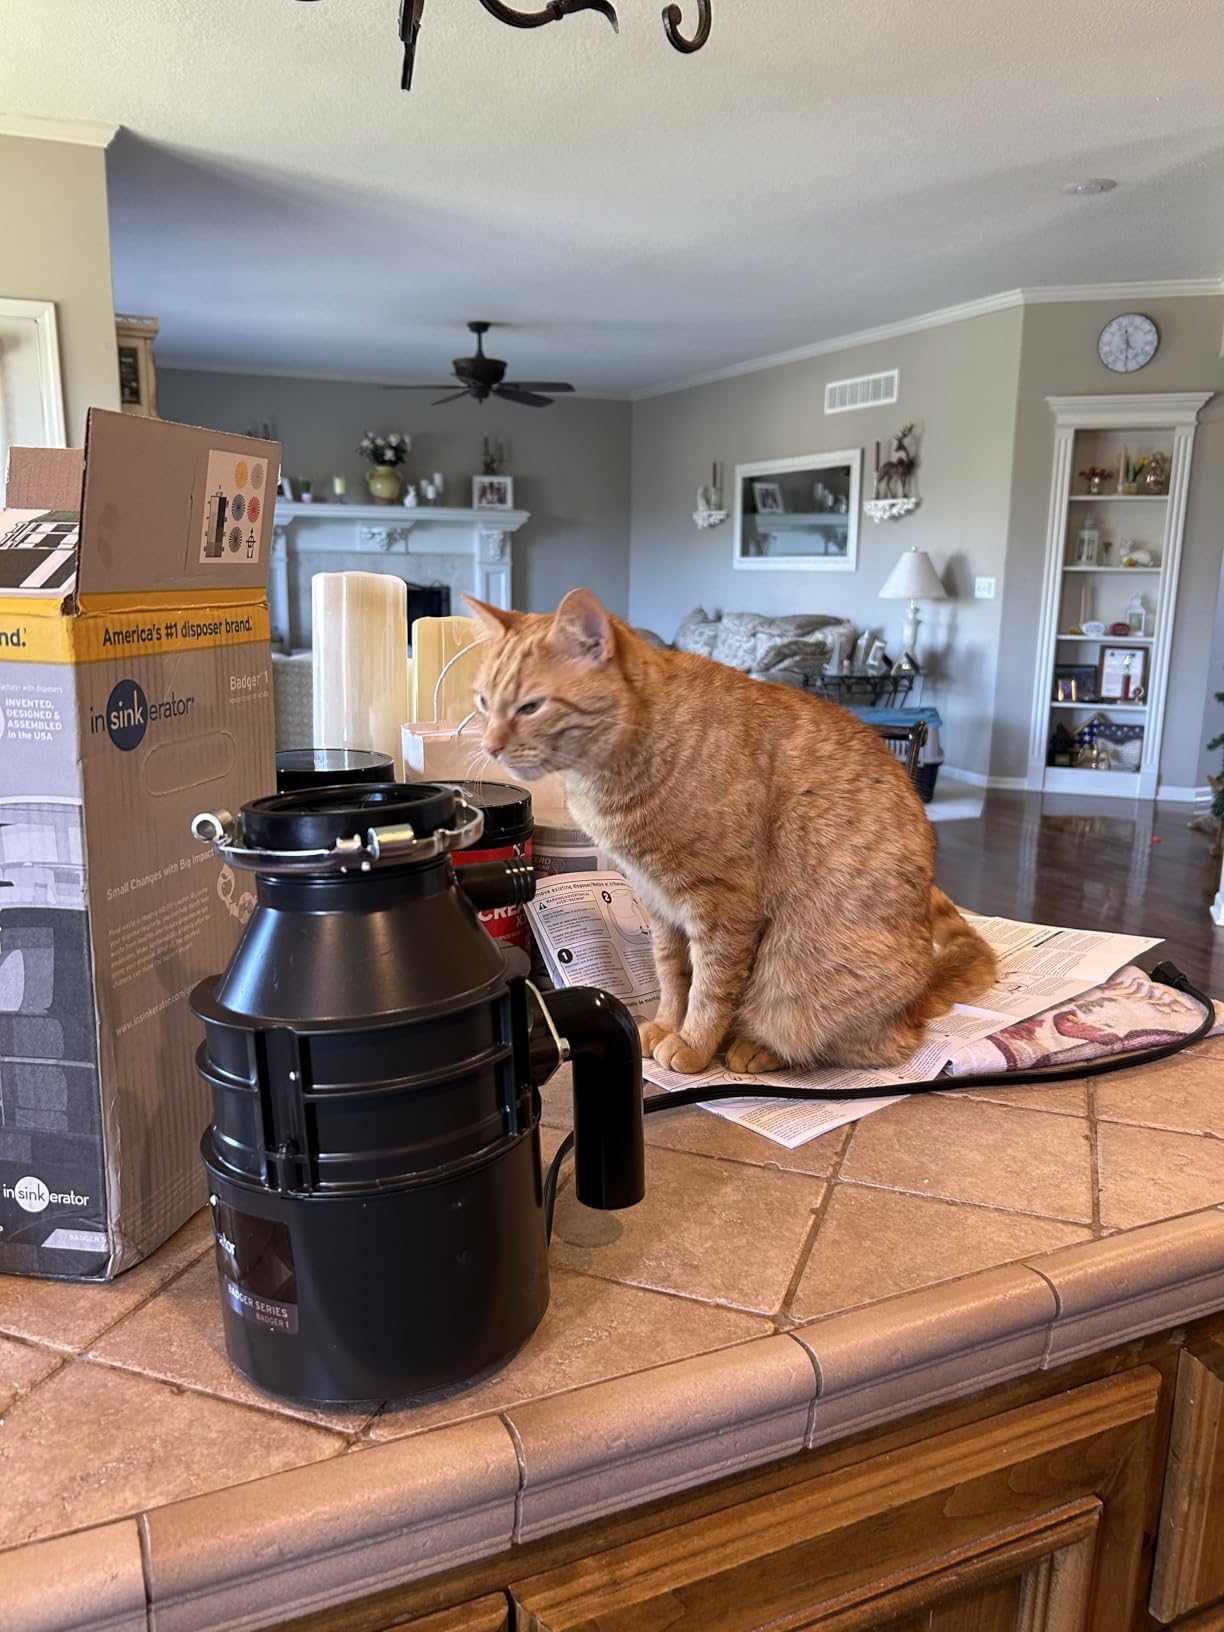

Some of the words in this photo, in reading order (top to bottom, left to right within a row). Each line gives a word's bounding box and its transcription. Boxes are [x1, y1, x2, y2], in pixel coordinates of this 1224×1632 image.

[102, 623, 162, 647] America's
[164, 622, 178, 639] #1
[181, 620, 223, 641] disposer
[224, 616, 253, 633] brand.
[5, 697, 55, 710] INVENTED,
[6, 708, 53, 720] DESIGNED
[53, 711, 61, 720] &
[7, 719, 62, 730] ASSEMBLED
[8, 731, 17, 739] in
[18, 731, 32, 739] the
[33, 731, 53, 741] USA
[106, 882, 129, 901] Small
[130, 869, 163, 891] Changes
[163, 862, 180, 876] with
[179, 856, 191, 872] Big
[192, 848, 215, 864] Impact
[255, 1300, 288, 1319] SERIES
[255, 1311, 284, 1328] BADGER
[284, 1320, 290, 1329] 1
